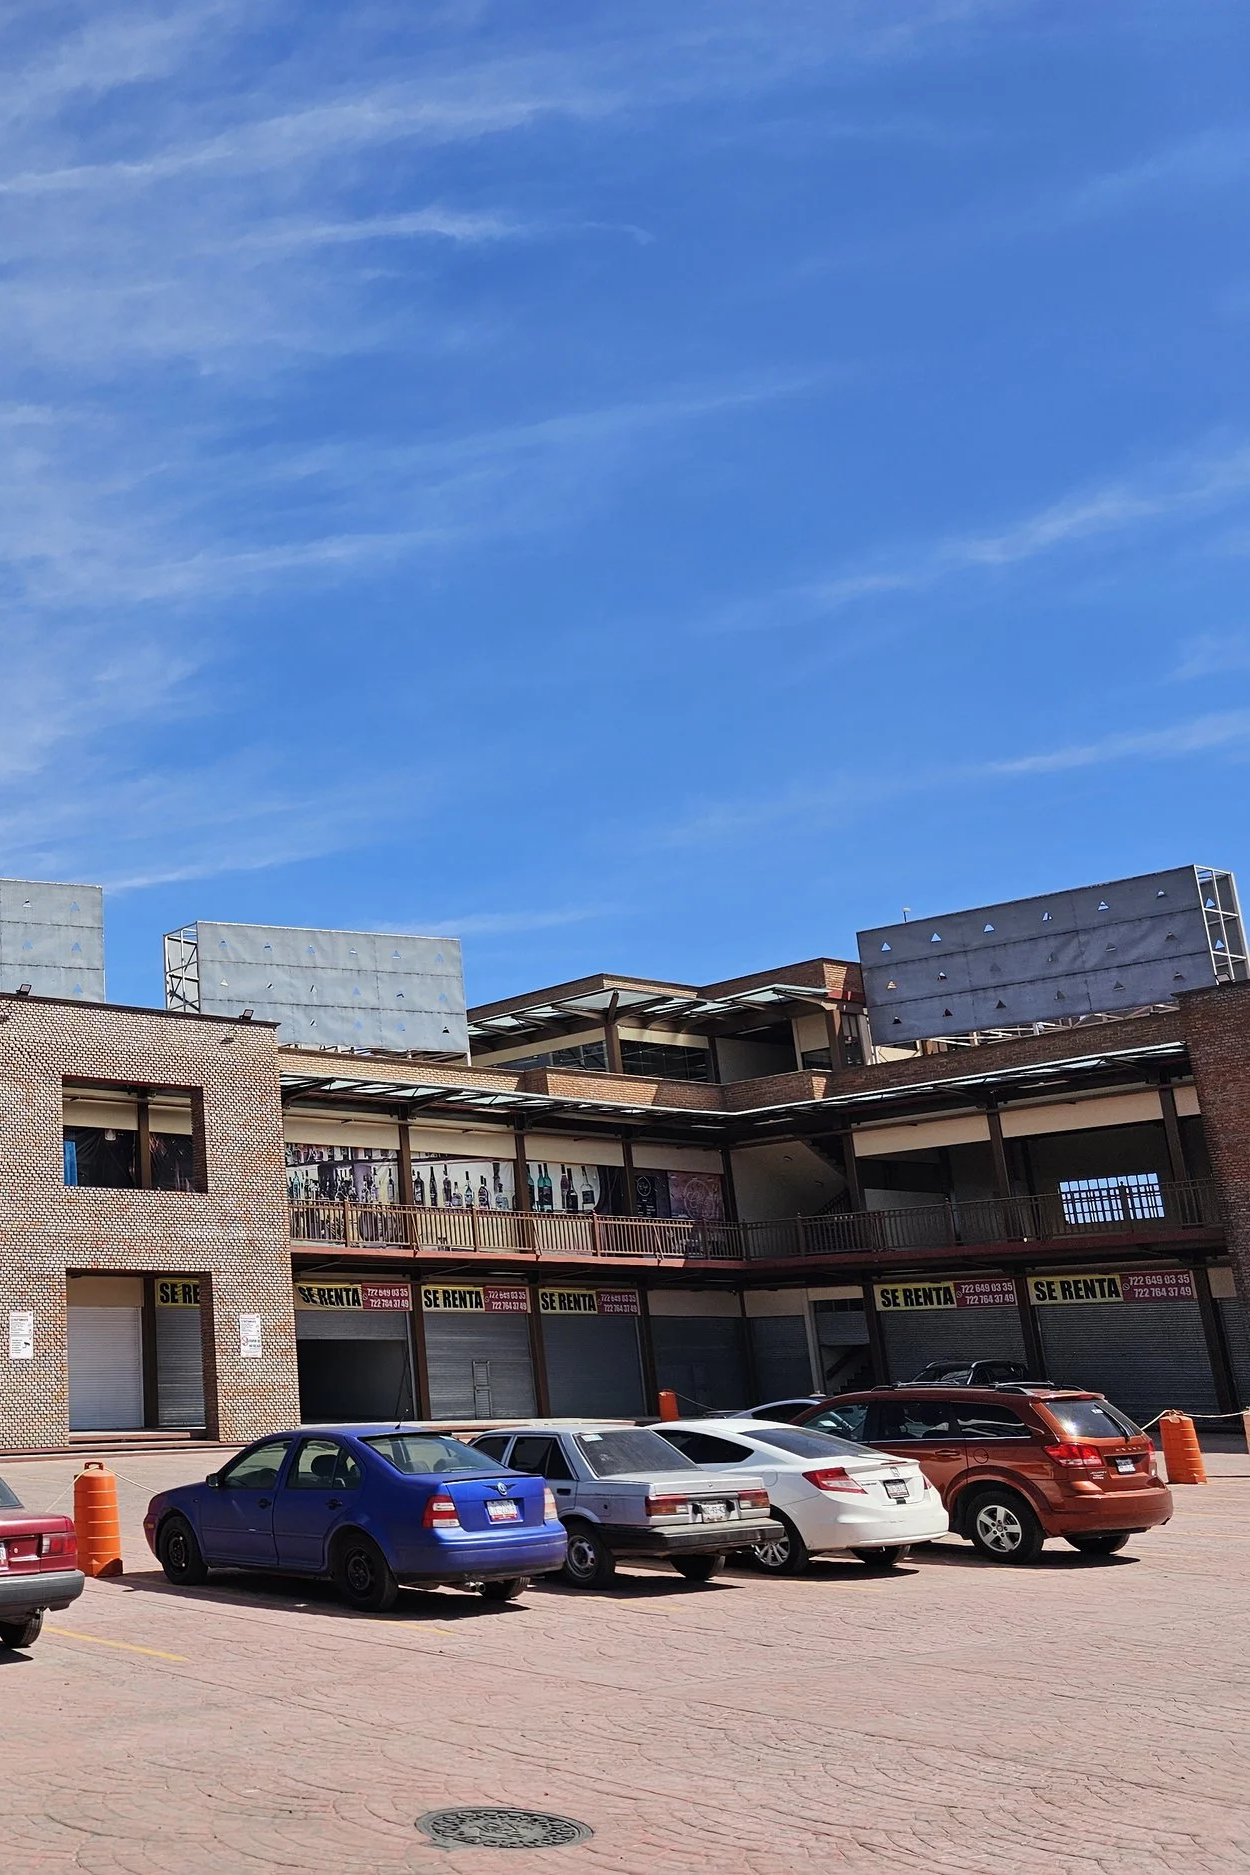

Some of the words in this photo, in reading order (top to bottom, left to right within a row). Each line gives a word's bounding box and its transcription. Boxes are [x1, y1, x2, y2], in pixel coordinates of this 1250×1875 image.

[961, 1285, 975, 1294] 722
[975, 1284, 990, 1293] 649
[991, 1283, 1002, 1292] 03
[1002, 1282, 1013, 1291] 35
[1034, 1281, 1058, 1301] SE
[1060, 1278, 1122, 1300] RENTA
[1129, 1276, 1144, 1286] 722
[1145, 1275, 1162, 1285] 649
[1164, 1275, 1176, 1284] 03
[1178, 1274, 1189, 1283] 35
[160, 1283, 178, 1303] SE
[298, 1287, 317, 1304] SE
[317, 1287, 361, 1307] RENTA
[424, 1289, 440, 1308] SE
[442, 1290, 483, 1309] RENTA
[541, 1292, 556, 1310] SE
[558, 1293, 596, 1311] RENTA
[880, 1288, 901, 1307] SE
[903, 1286, 955, 1307] RENTA
[965, 1295, 979, 1304] 722
[980, 1295, 994, 1304] 764
[994, 1294, 1004, 1303] 37
[1004, 1294, 1015, 1303] 49
[1134, 1288, 1149, 1298] 722
[1151, 1288, 1167, 1297] 764
[1168, 1287, 1178, 1296] 37
[1180, 1286, 1192, 1296] 49
